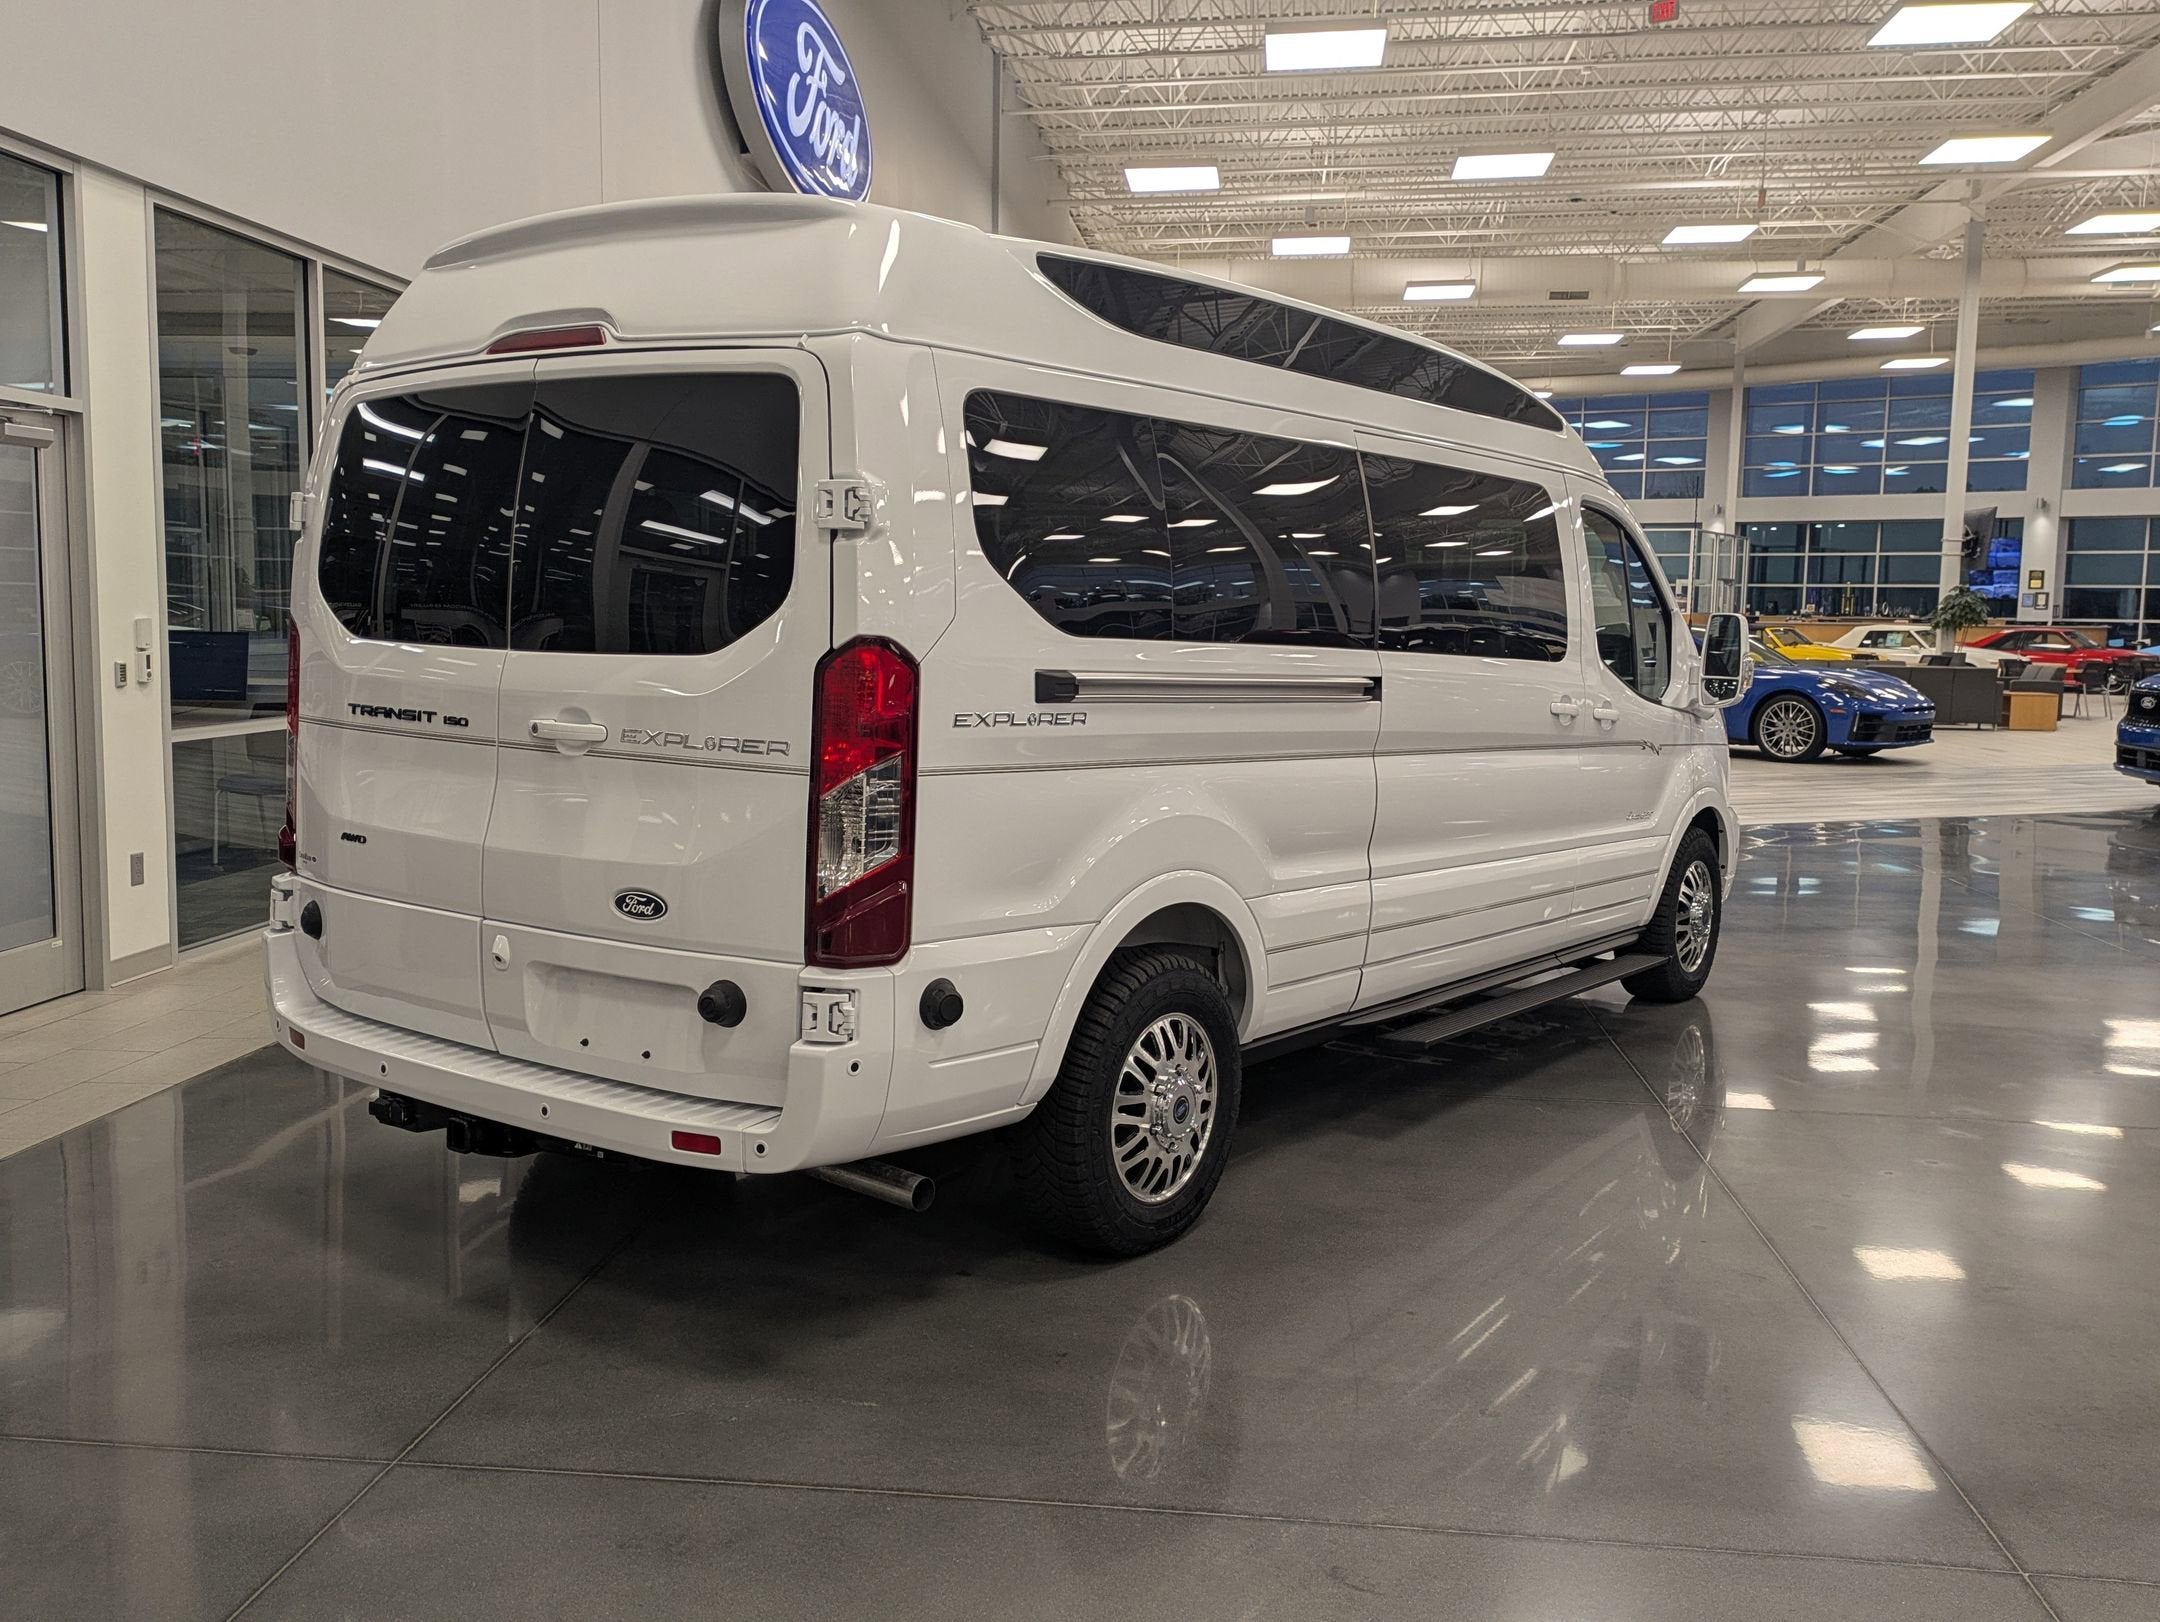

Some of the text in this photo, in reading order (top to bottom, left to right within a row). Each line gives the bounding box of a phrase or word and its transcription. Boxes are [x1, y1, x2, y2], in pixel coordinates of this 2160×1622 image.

[788, 22, 861, 187] Ford
[348, 703, 469, 727] TRANSIT 150
[953, 711, 1088, 728] EXPLORER
[620, 728, 791, 756] EXPLORER
[341, 832, 367, 844] AWD
[622, 895, 655, 915] Ford
